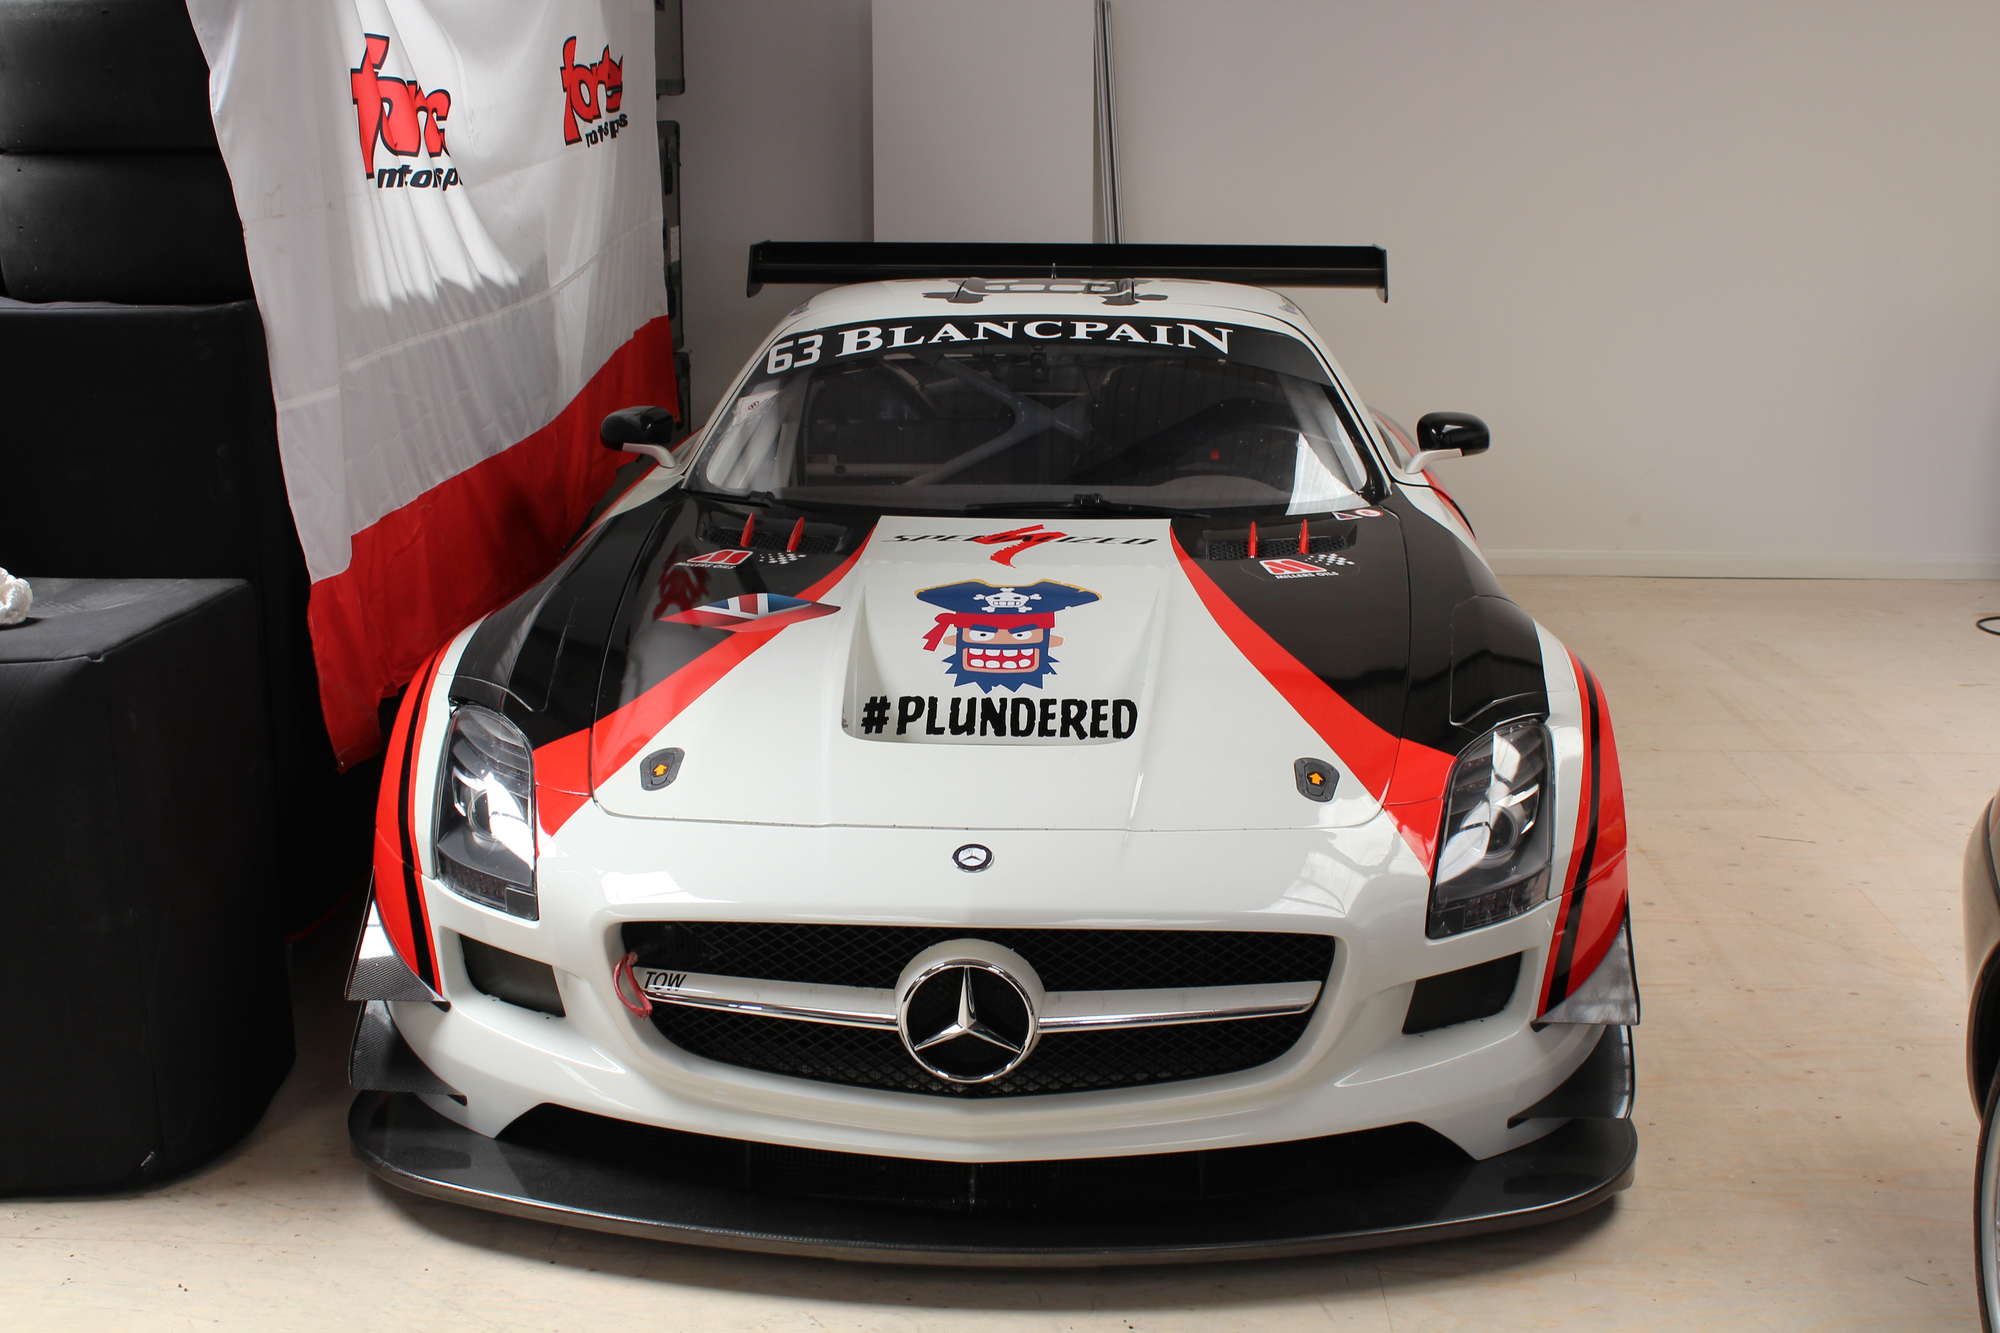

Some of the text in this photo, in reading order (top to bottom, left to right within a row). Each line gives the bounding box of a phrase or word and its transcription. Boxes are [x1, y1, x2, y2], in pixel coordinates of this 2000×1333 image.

[767, 334, 823, 374] 63
[835, 320, 1233, 357] BLANCPAIN
[861, 695, 1138, 740] #PLUNDERED
[644, 970, 688, 989] TOW
